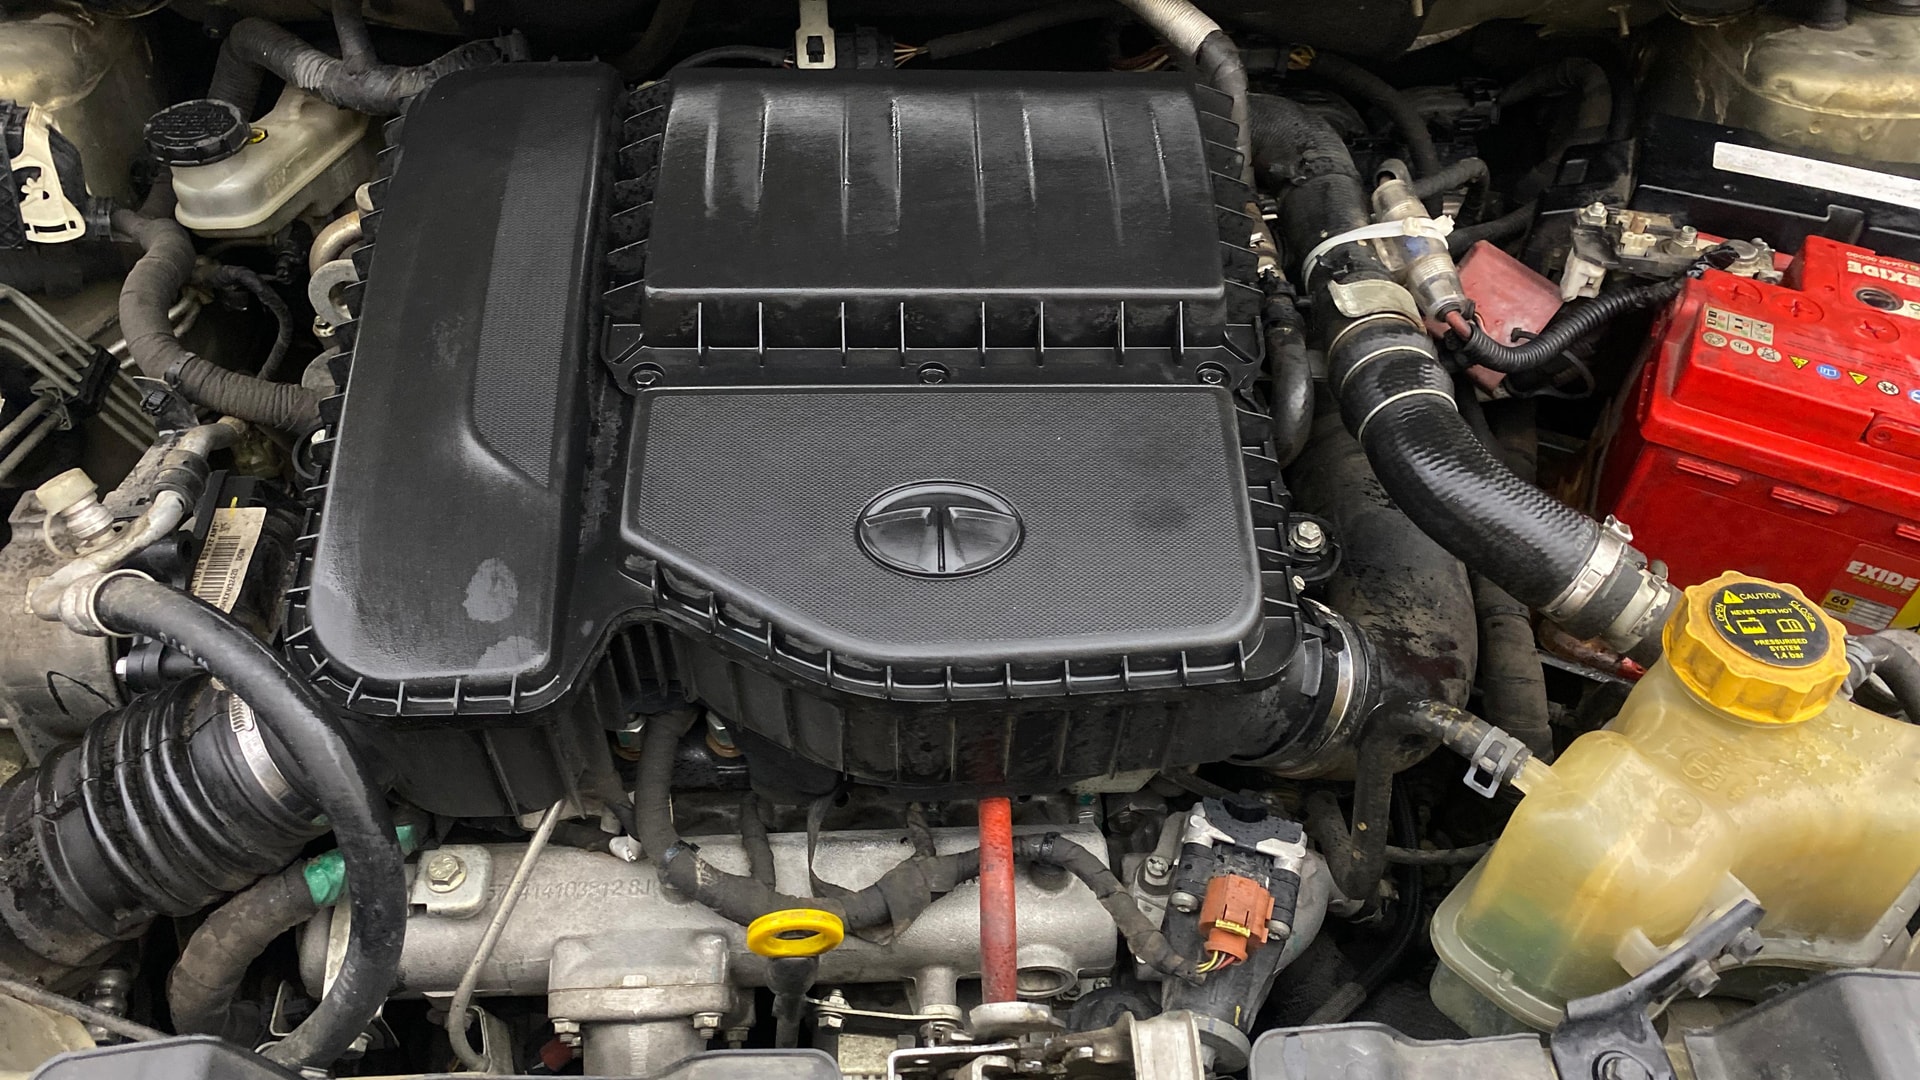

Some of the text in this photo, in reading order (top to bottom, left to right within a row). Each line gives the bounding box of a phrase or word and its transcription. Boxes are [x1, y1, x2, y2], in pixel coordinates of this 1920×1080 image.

[1847, 260, 1920, 288] EXIDE
[1733, 341, 1750, 352] Pb
[1846, 560, 1920, 591] EXIDE
[1739, 592, 1781, 600] CAUTION
[1831, 595, 1850, 606] 60
[1714, 602, 1724, 622] OPEN
[1730, 608, 1756, 616] NEVER
[1753, 638, 1808, 646] PRESSURISED
[1788, 651, 1804, 659] bar
